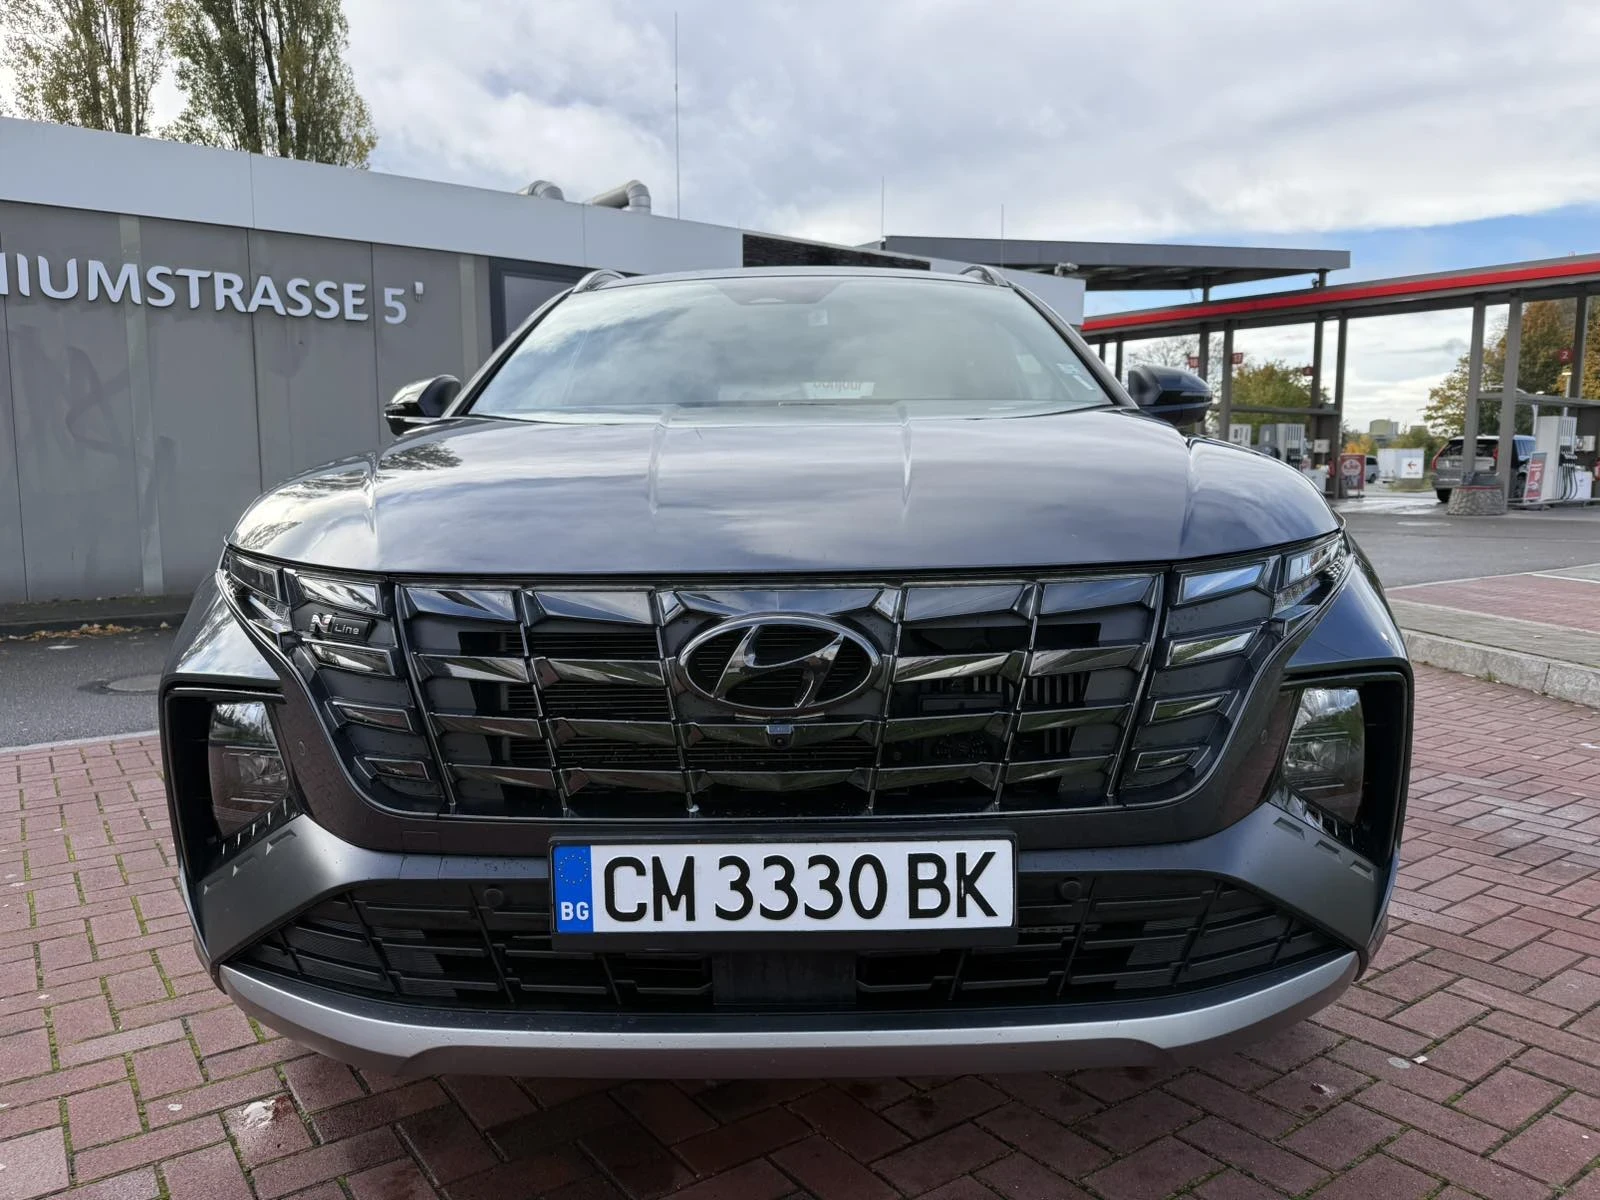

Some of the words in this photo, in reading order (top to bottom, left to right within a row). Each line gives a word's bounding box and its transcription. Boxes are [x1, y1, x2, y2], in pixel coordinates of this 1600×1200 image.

[335, 623, 360, 635] Line
[603, 855, 696, 922] CM
[714, 853, 888, 922] 3330
[907, 851, 998, 920] BK
[560, 903, 590, 921] BG
